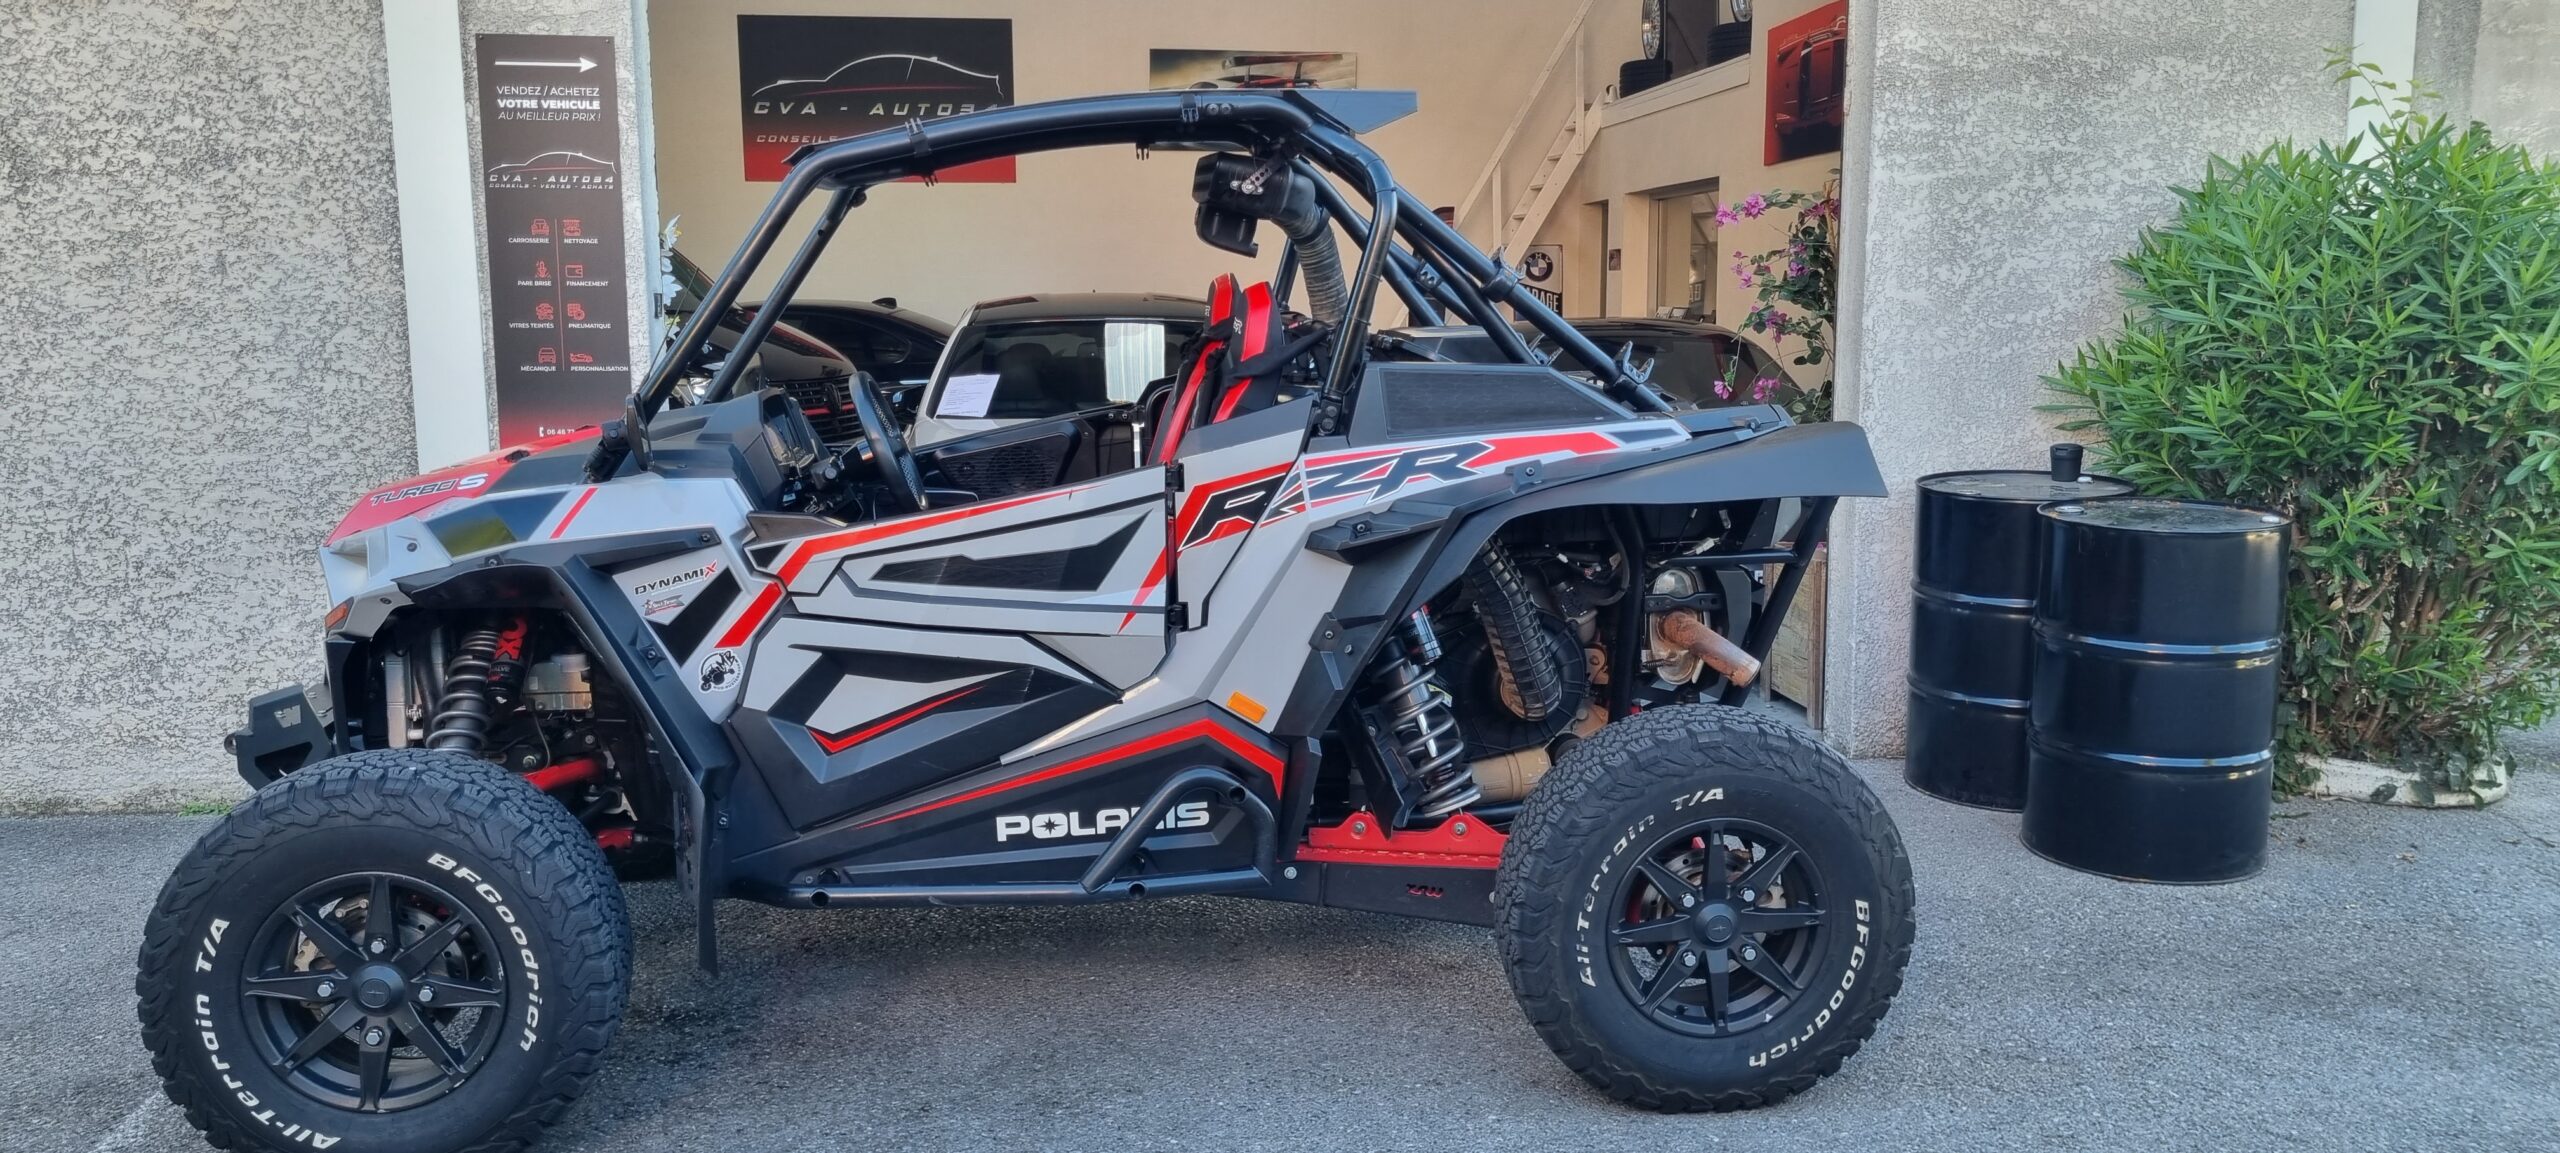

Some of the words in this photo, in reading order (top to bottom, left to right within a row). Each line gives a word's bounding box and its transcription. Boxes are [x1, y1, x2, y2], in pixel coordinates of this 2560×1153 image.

[496, 85, 541, 96] VENDEZ
[543, 85, 549, 97] /
[549, 87, 600, 97] ACHETEZ
[497, 99, 539, 109] VOTRE
[540, 100, 601, 110] VEHICULE
[753, 101, 817, 116] CVA
[498, 111, 514, 121] AU
[515, 112, 570, 121] MEILLEUR
[571, 112, 598, 122] PRIX
[489, 174, 522, 182] CVA
[371, 478, 459, 507] TURBO
[457, 473, 489, 490] S
[1177, 440, 1496, 552] RZR
[634, 560, 718, 595] DYNAMIX
[996, 801, 1210, 842] POLAIS
[1576, 814, 1656, 988] All-Terrain
[1671, 787, 1724, 812] T/A
[195, 917, 231, 974] T/A
[427, 852, 542, 1052] BFGoodrich
[1748, 900, 1871, 1068] BFGoodrich
[195, 993, 342, 1151] All-Terrain
